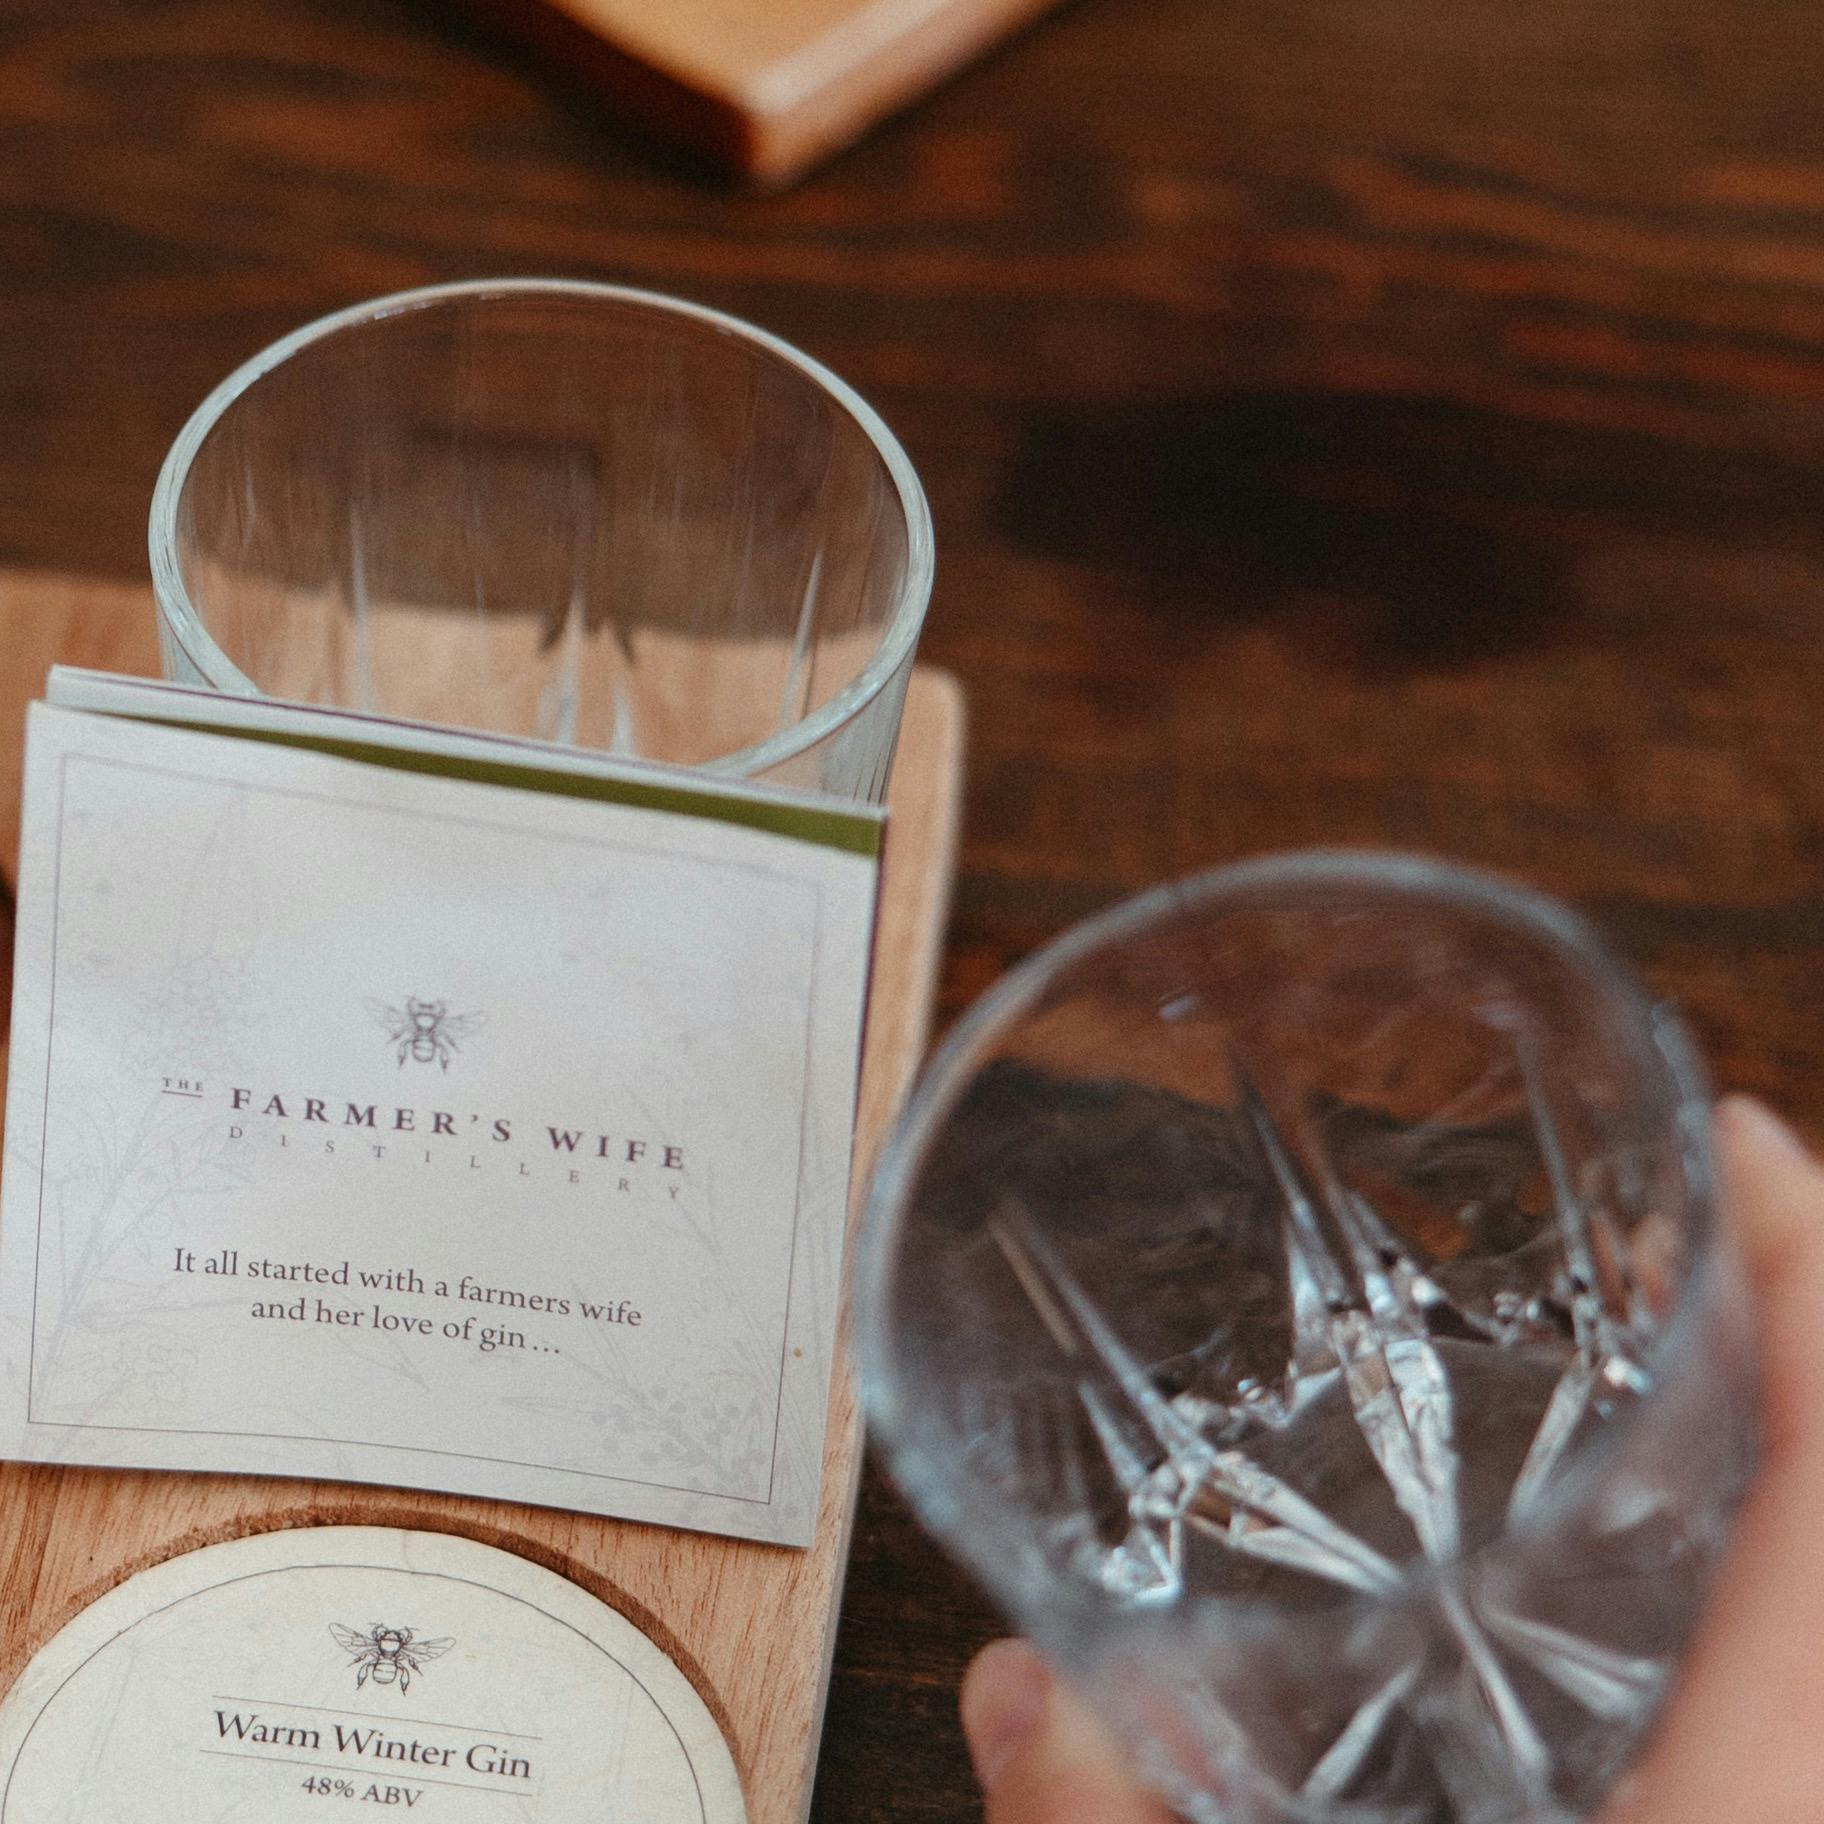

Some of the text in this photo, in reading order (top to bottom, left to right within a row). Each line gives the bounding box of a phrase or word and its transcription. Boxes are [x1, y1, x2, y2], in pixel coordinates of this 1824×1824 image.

[162, 1077, 685, 1171] THE FARMER'S WIFE
[229, 1126, 680, 1200] DISTILLERY
[173, 1247, 643, 1328] It all started with a farmers wife
[250, 1297, 307, 1322] and
[314, 1301, 365, 1327] her
[371, 1306, 434, 1336] love
[442, 1317, 474, 1341] of
[214, 1709, 534, 1779] Warm Winter Gin
[301, 1776, 424, 1809] 48% ABV
